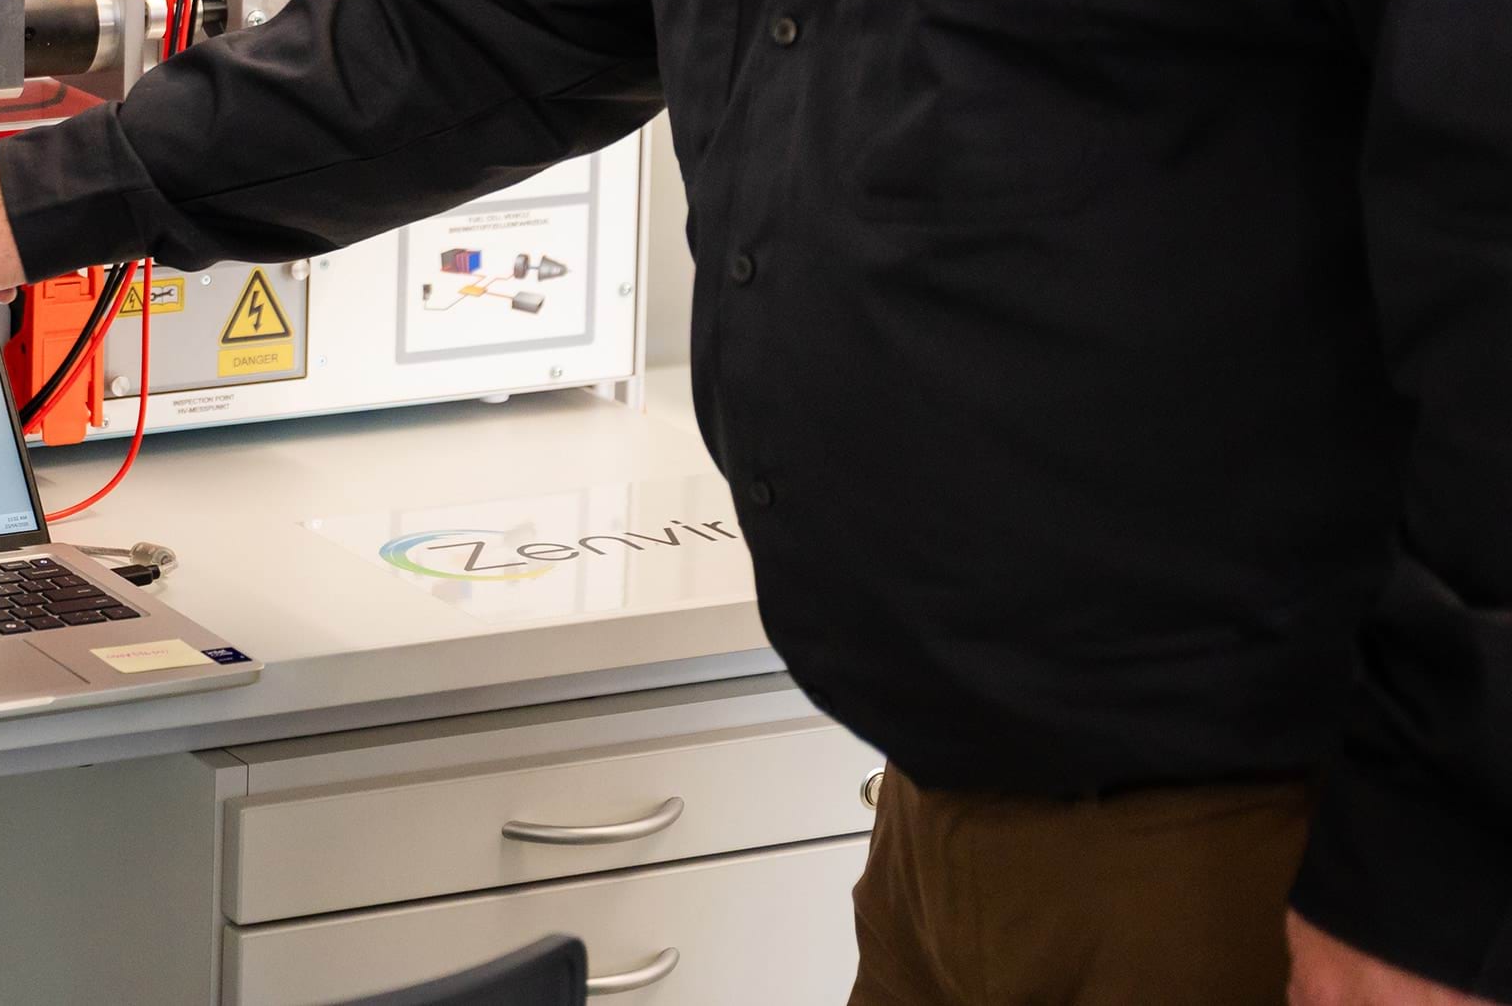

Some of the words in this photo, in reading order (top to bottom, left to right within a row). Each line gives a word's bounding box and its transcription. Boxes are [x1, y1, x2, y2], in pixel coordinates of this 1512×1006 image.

[232, 353, 280, 368] DANGER
[215, 393, 236, 402] POINT
[426, 519, 739, 572] Zenvir
